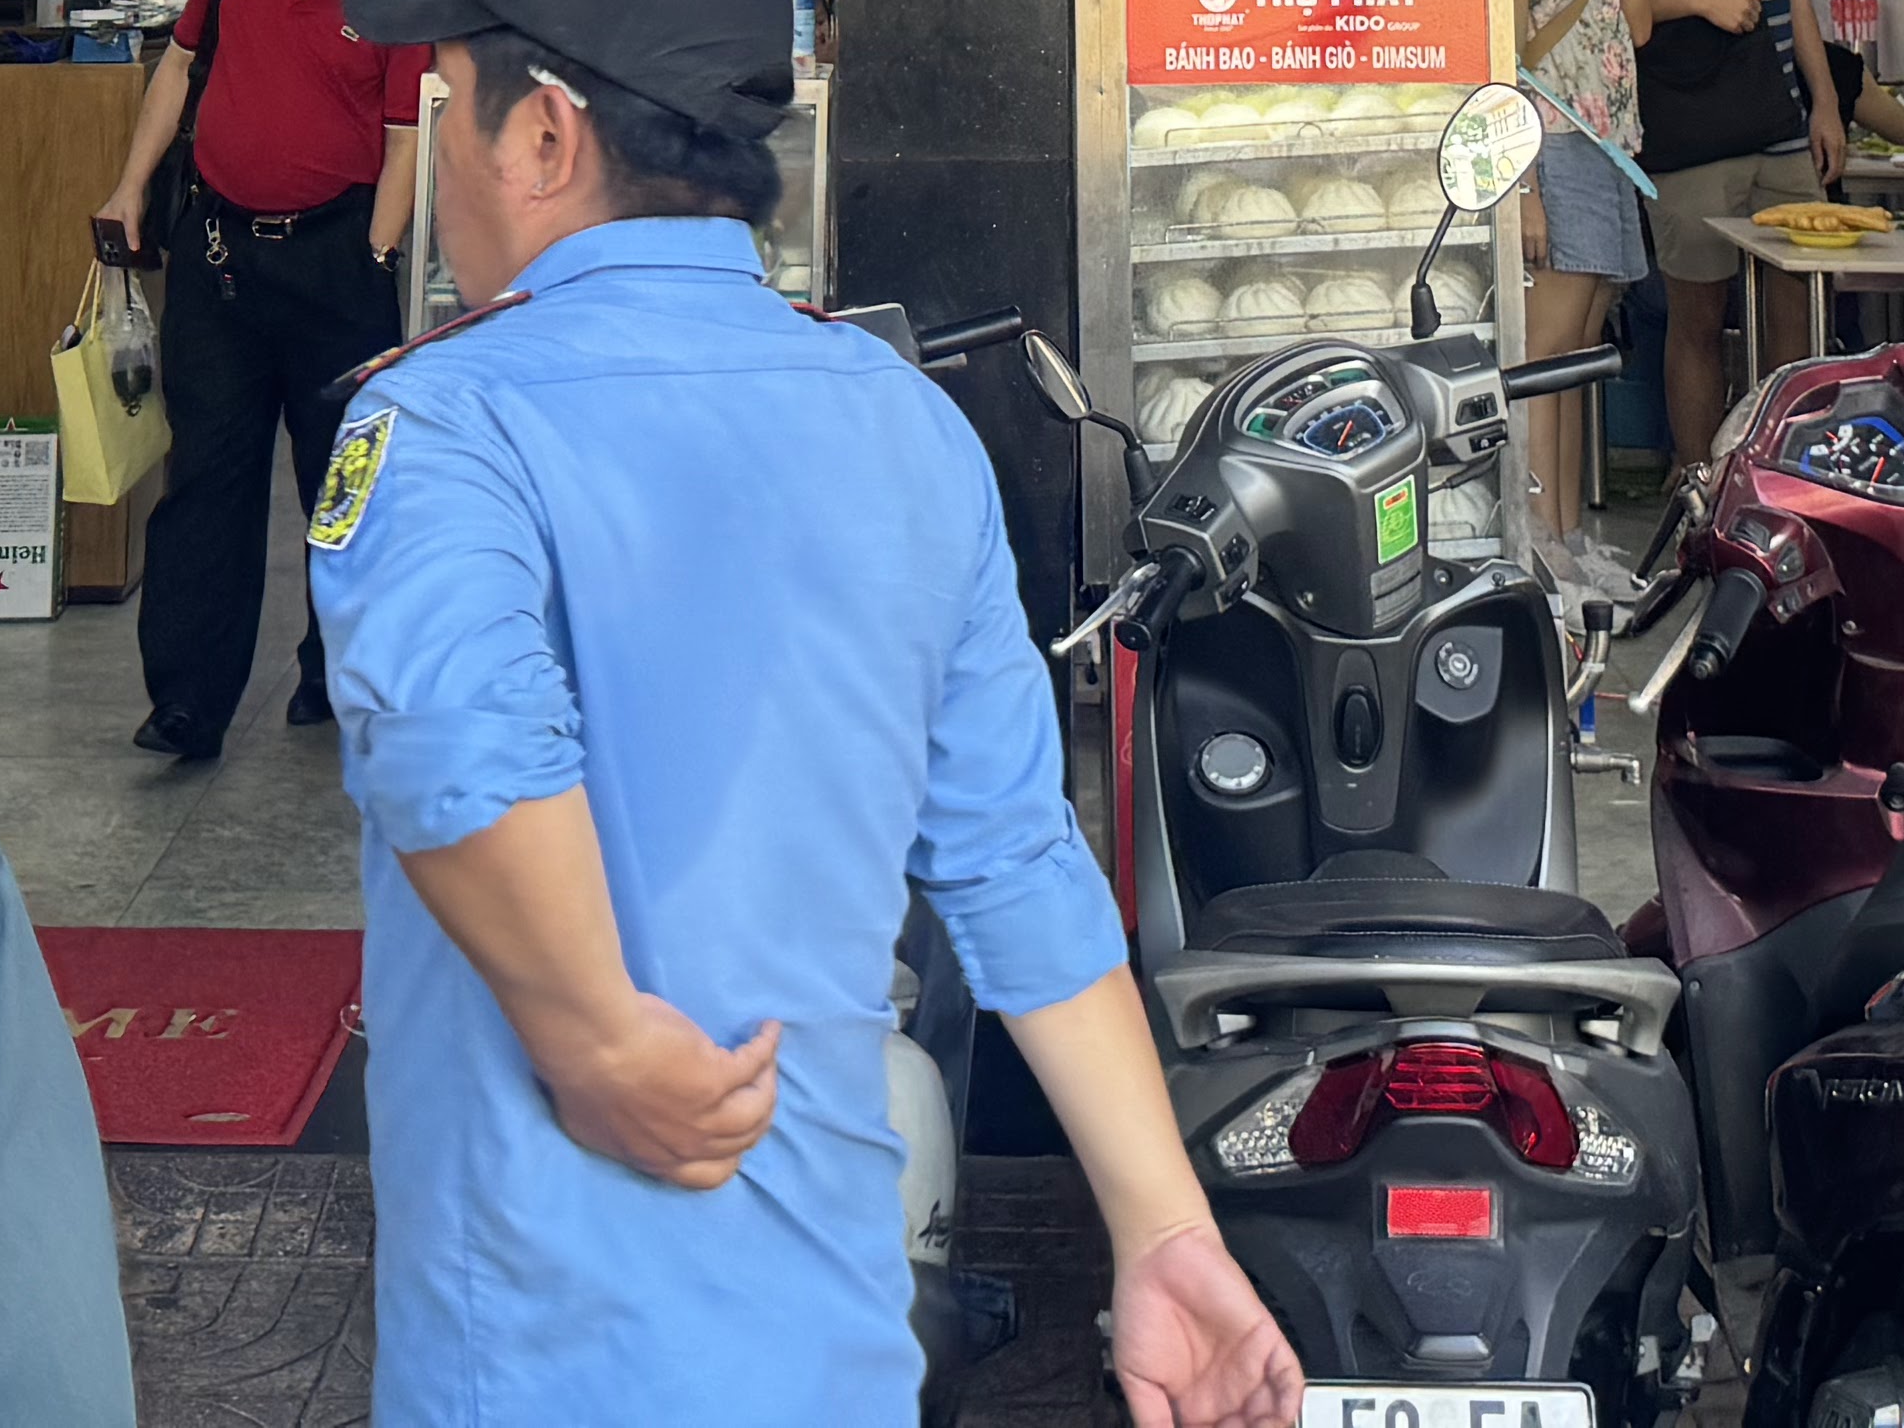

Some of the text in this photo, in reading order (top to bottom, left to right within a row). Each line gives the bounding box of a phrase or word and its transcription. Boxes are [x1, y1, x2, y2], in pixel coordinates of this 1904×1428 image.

[1335, 15, 1385, 32] KIDO
[1165, 42, 1214, 71] BÁNH
[1219, 46, 1255, 70] BAO
[1270, 40, 1321, 70] BÁNH
[1325, 40, 1355, 68] GIÒ
[1372, 45, 1446, 69] DIMSUM
